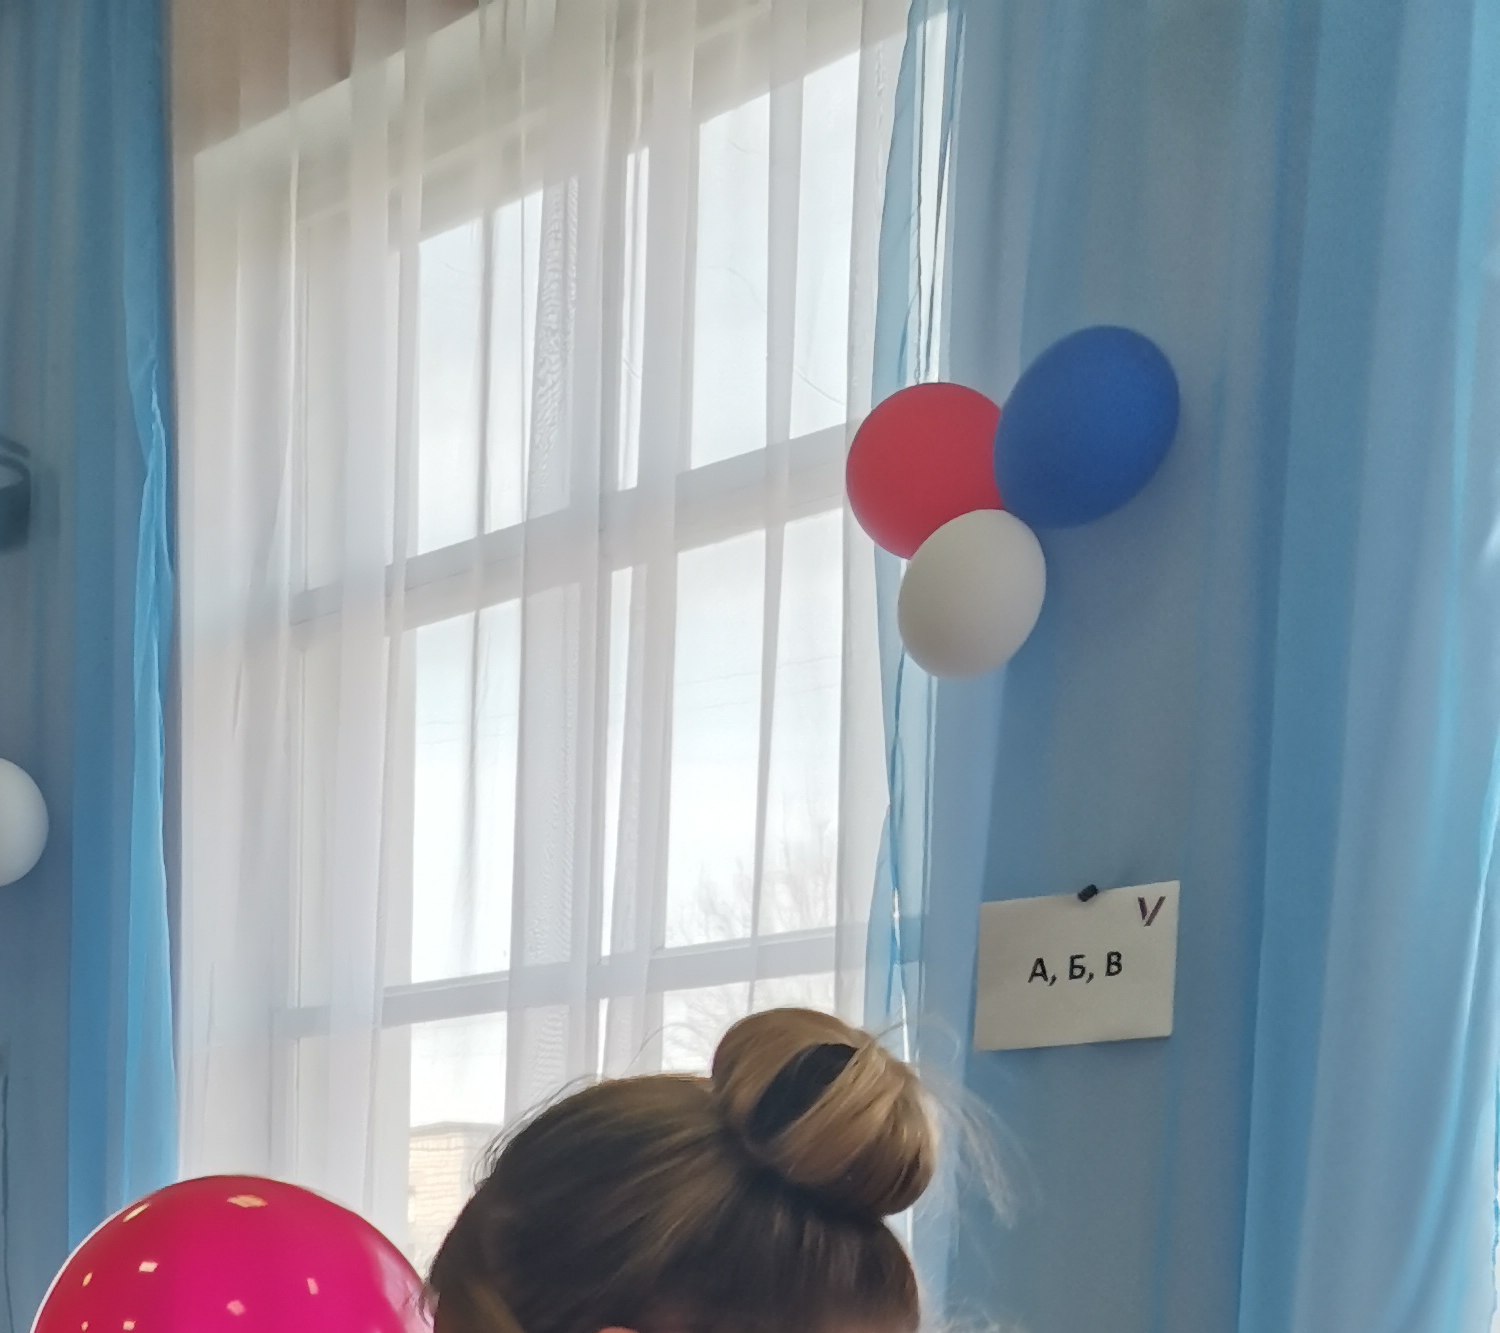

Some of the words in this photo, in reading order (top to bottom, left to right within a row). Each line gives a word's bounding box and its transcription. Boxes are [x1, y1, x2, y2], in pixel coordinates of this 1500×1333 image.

[1028, 957, 1057, 986] А,
[1068, 954, 1095, 983] Б,
[1105, 951, 1123, 977] В
